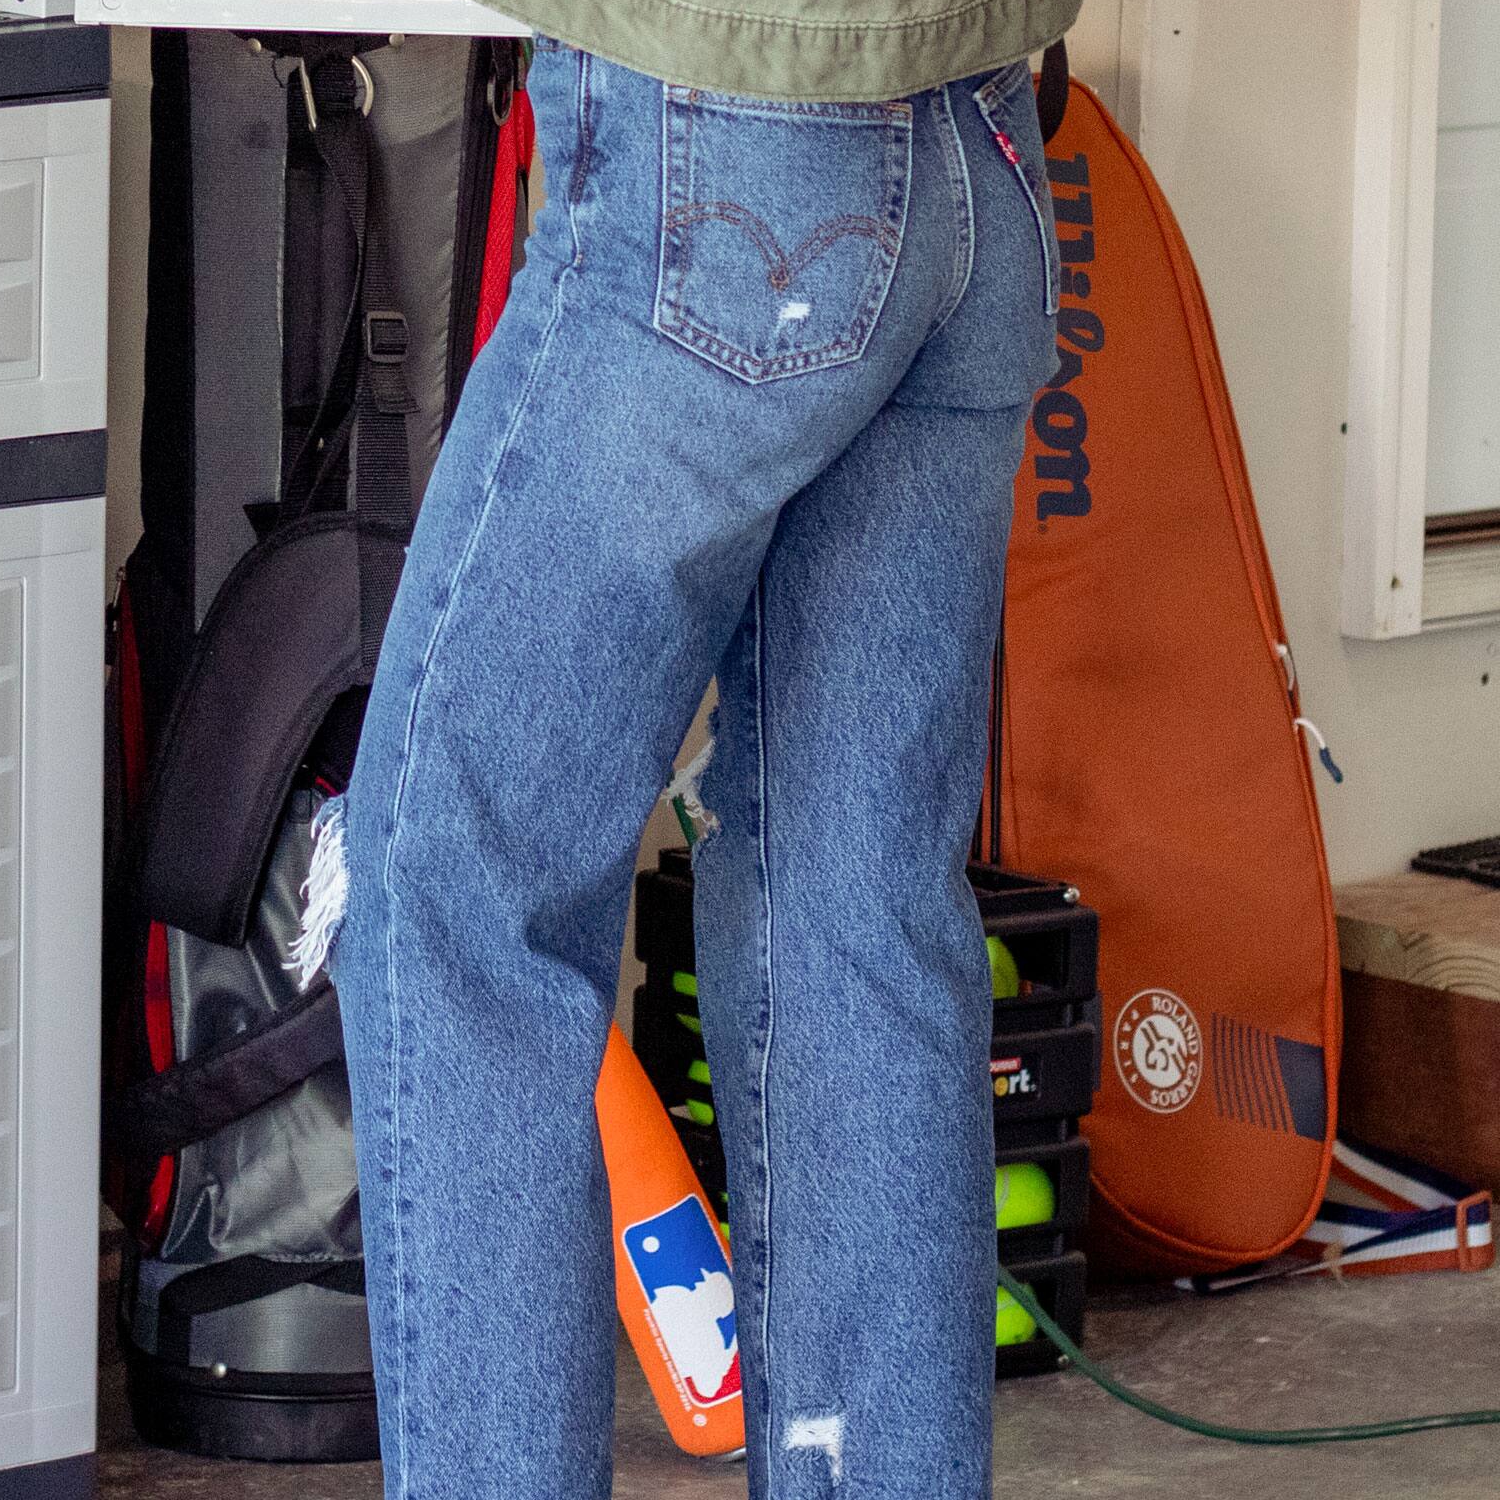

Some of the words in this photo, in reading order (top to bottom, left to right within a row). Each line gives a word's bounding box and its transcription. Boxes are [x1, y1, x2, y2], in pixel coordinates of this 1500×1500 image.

[1120, 1009, 1140, 1084] PARIS
[1152, 995, 1200, 1055] ROLAND
[1150, 1060, 1198, 1106] GARROS
